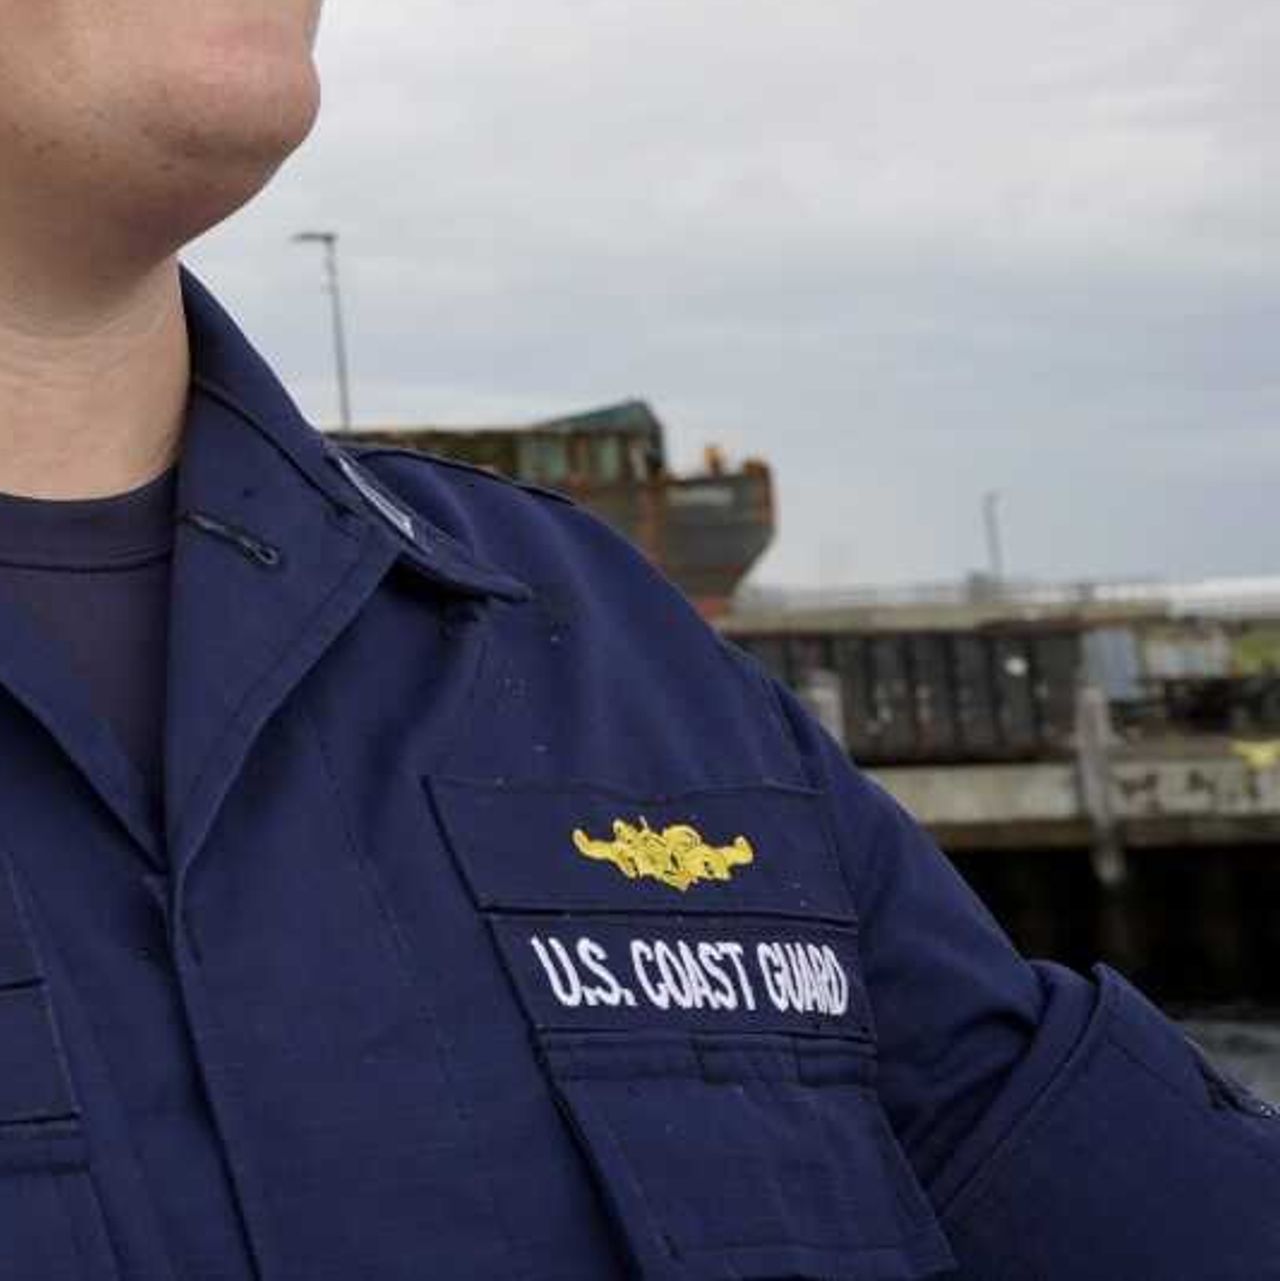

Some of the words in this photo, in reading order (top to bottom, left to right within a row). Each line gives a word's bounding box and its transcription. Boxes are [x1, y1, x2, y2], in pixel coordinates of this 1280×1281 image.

[530, 934, 637, 1007] U.S.
[630, 938, 756, 1011] COAST
[756, 941, 849, 1017] GUARD
